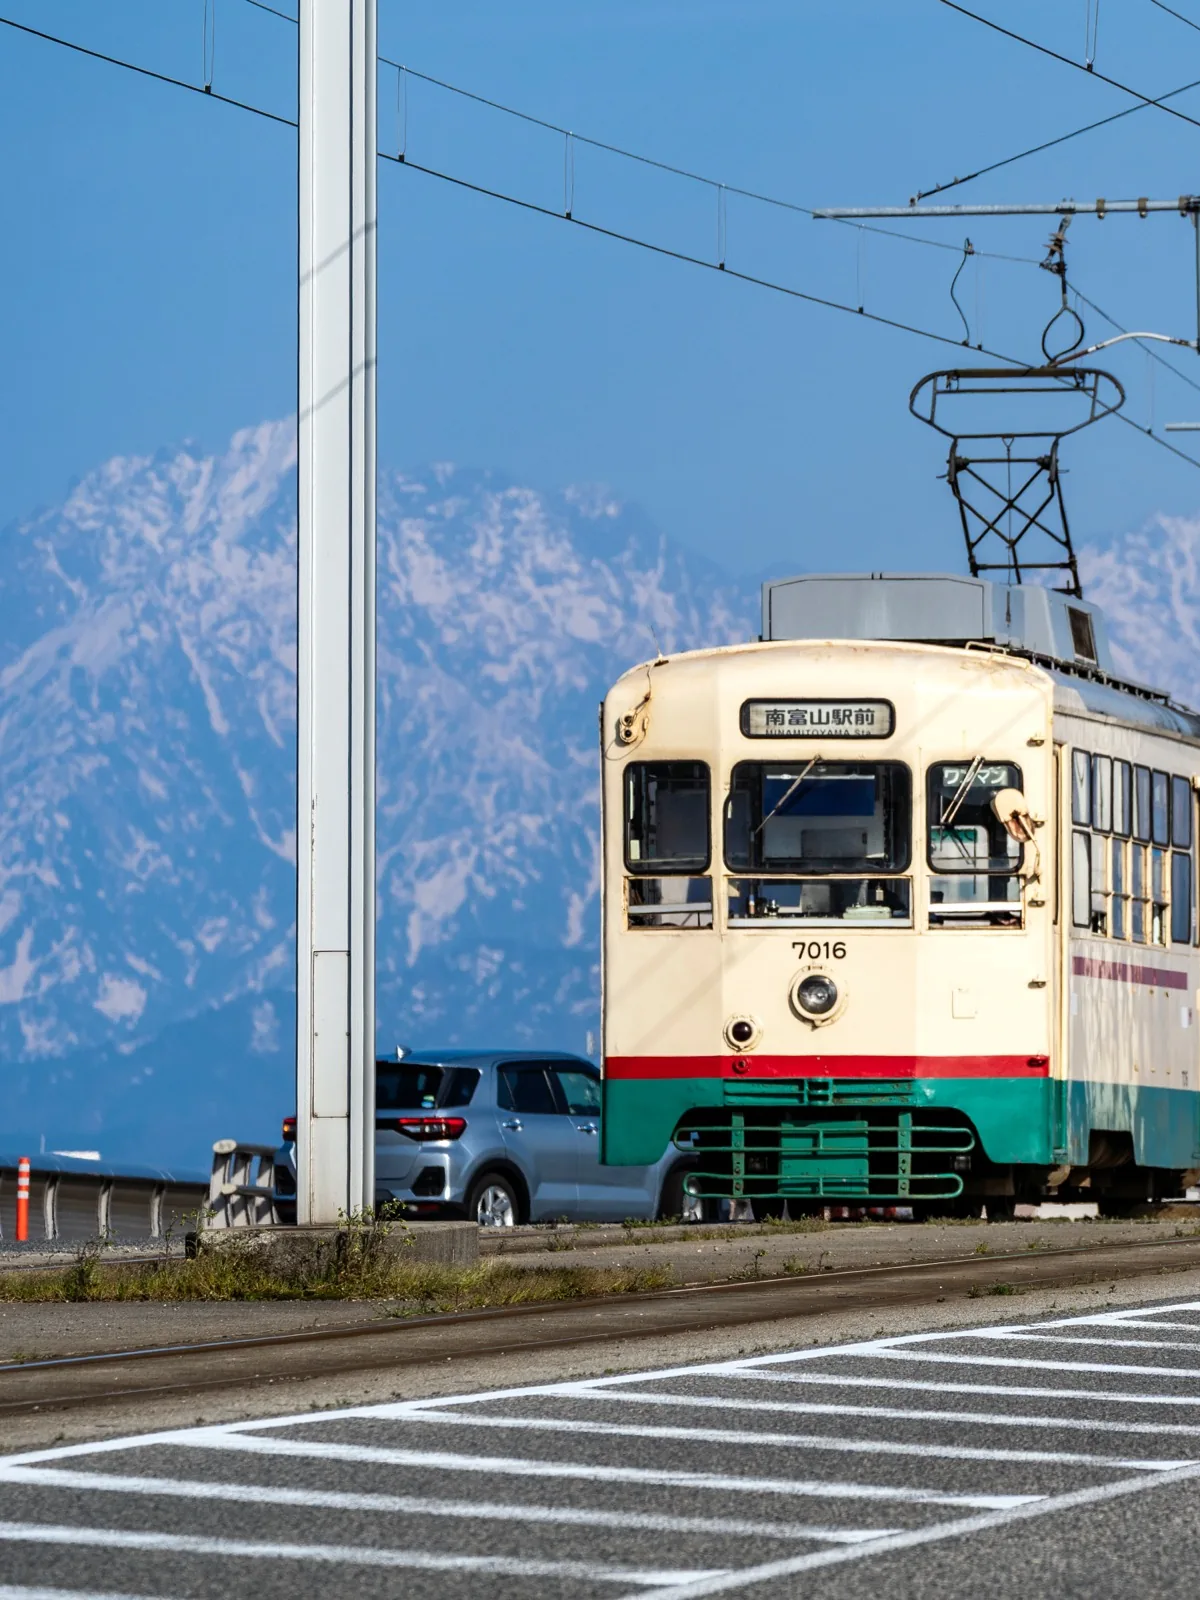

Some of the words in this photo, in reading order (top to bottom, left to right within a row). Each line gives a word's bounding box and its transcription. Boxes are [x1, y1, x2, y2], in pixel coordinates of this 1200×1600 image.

[765, 708, 875, 726] 南富山駅前
[792, 941, 847, 960] 7016
